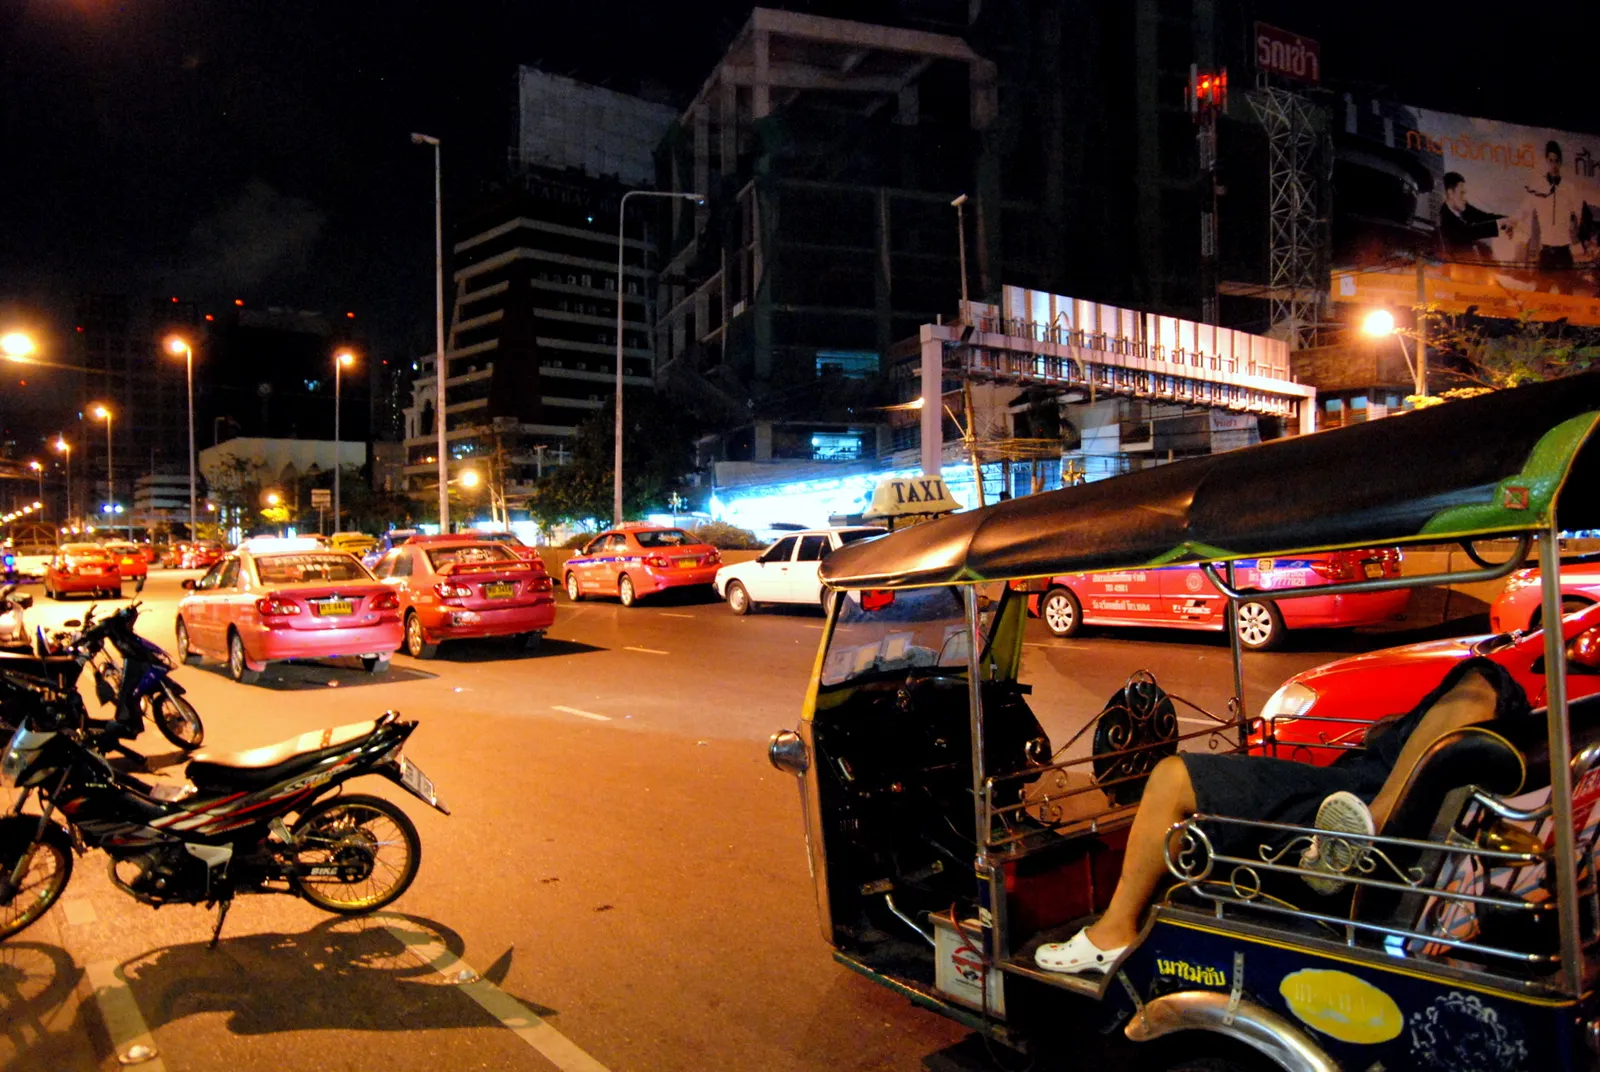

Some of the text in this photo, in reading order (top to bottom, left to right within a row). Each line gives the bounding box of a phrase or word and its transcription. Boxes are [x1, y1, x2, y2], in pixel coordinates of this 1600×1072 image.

[891, 480, 945, 503] TAXI
[1156, 958, 1226, 986] เมาไม่ขับ
